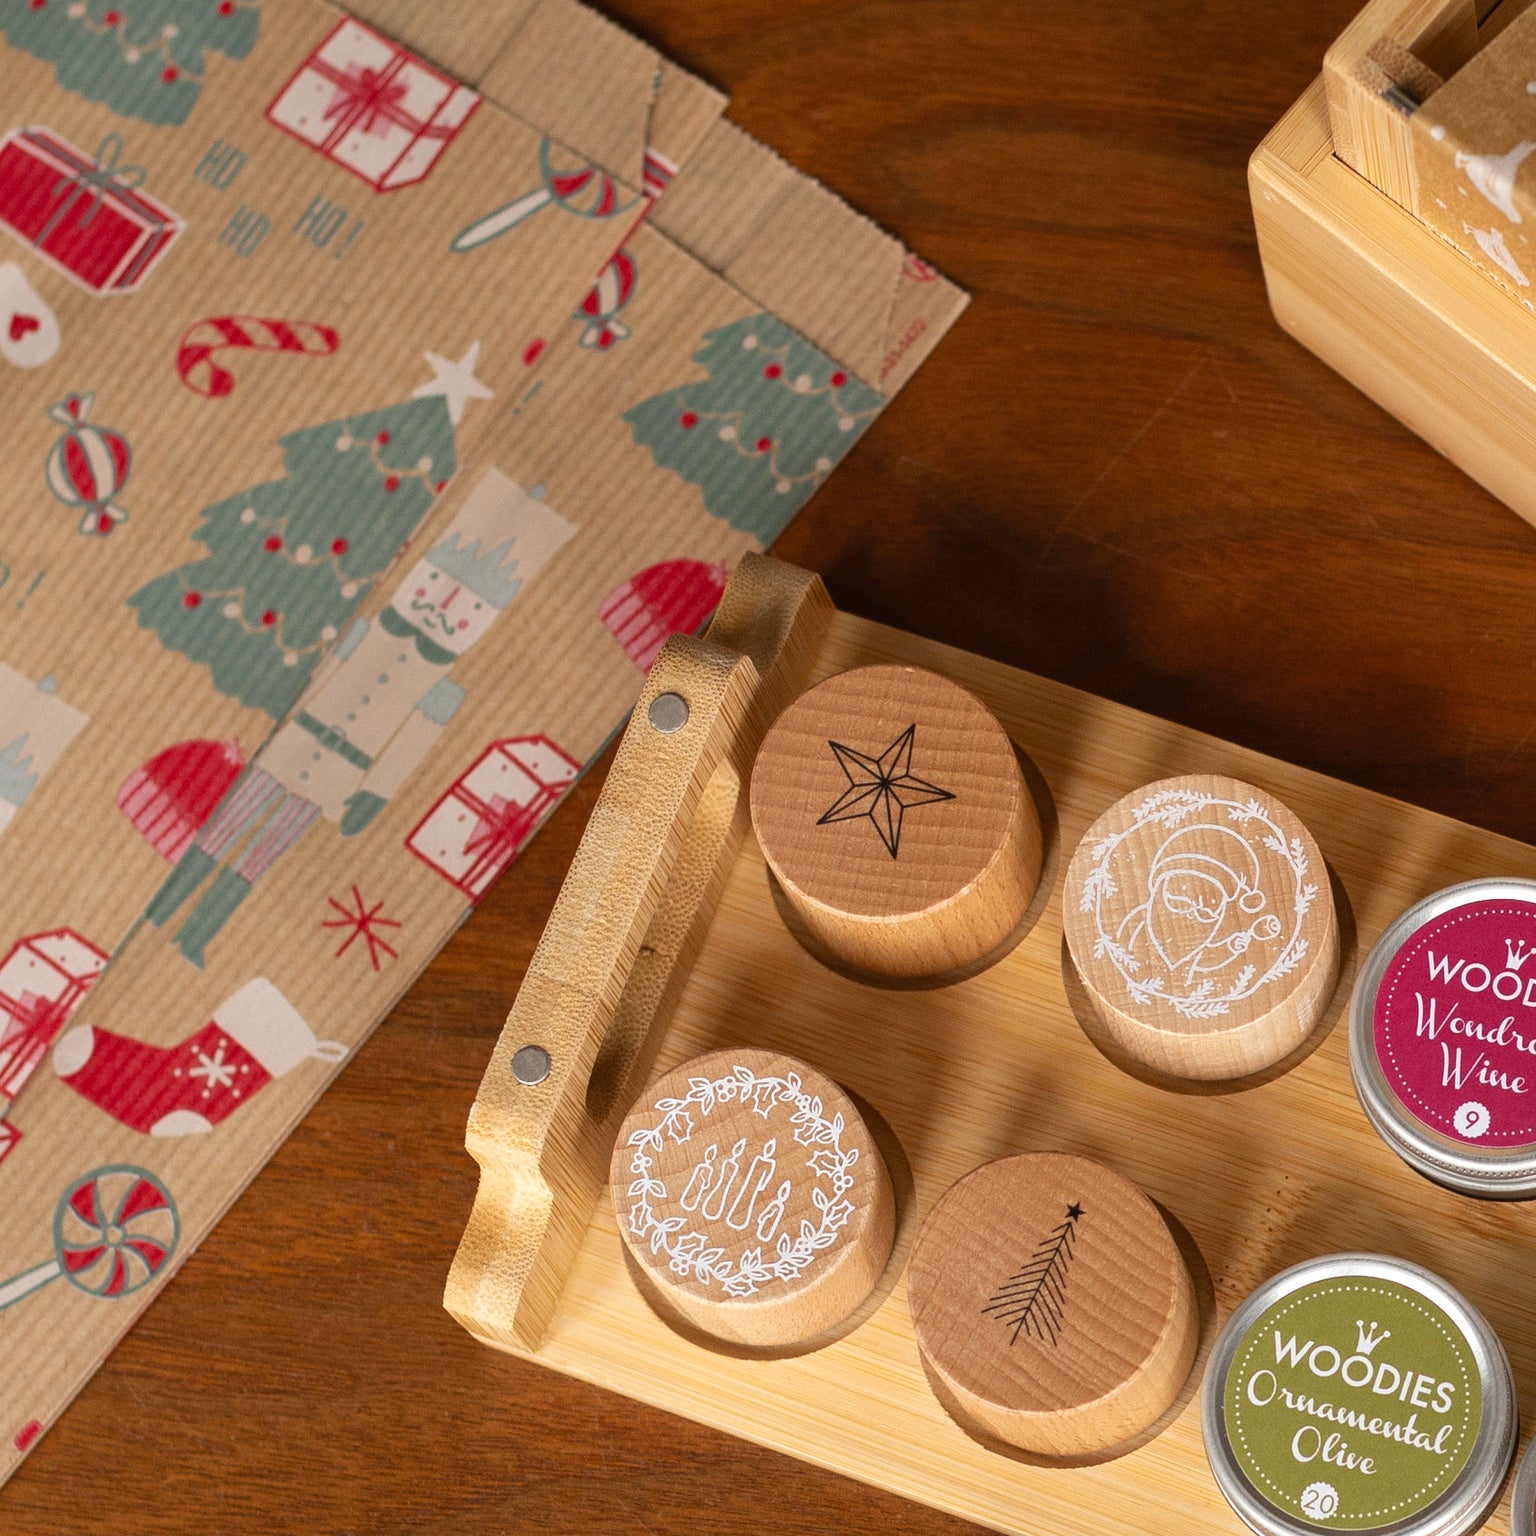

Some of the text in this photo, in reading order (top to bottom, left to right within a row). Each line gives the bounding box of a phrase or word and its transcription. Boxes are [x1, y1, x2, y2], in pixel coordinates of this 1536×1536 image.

[193, 138, 248, 192] HO
[217, 204, 272, 257] HO
[1441, 1041, 1528, 1094] Wine
[1464, 1110, 1480, 1130] 9
[1274, 1330, 1456, 1414] WOODIES
[1247, 1369, 1453, 1454] Ornamental
[1291, 1425, 1377, 1475] Olive
[1303, 1488, 1335, 1515] 20
